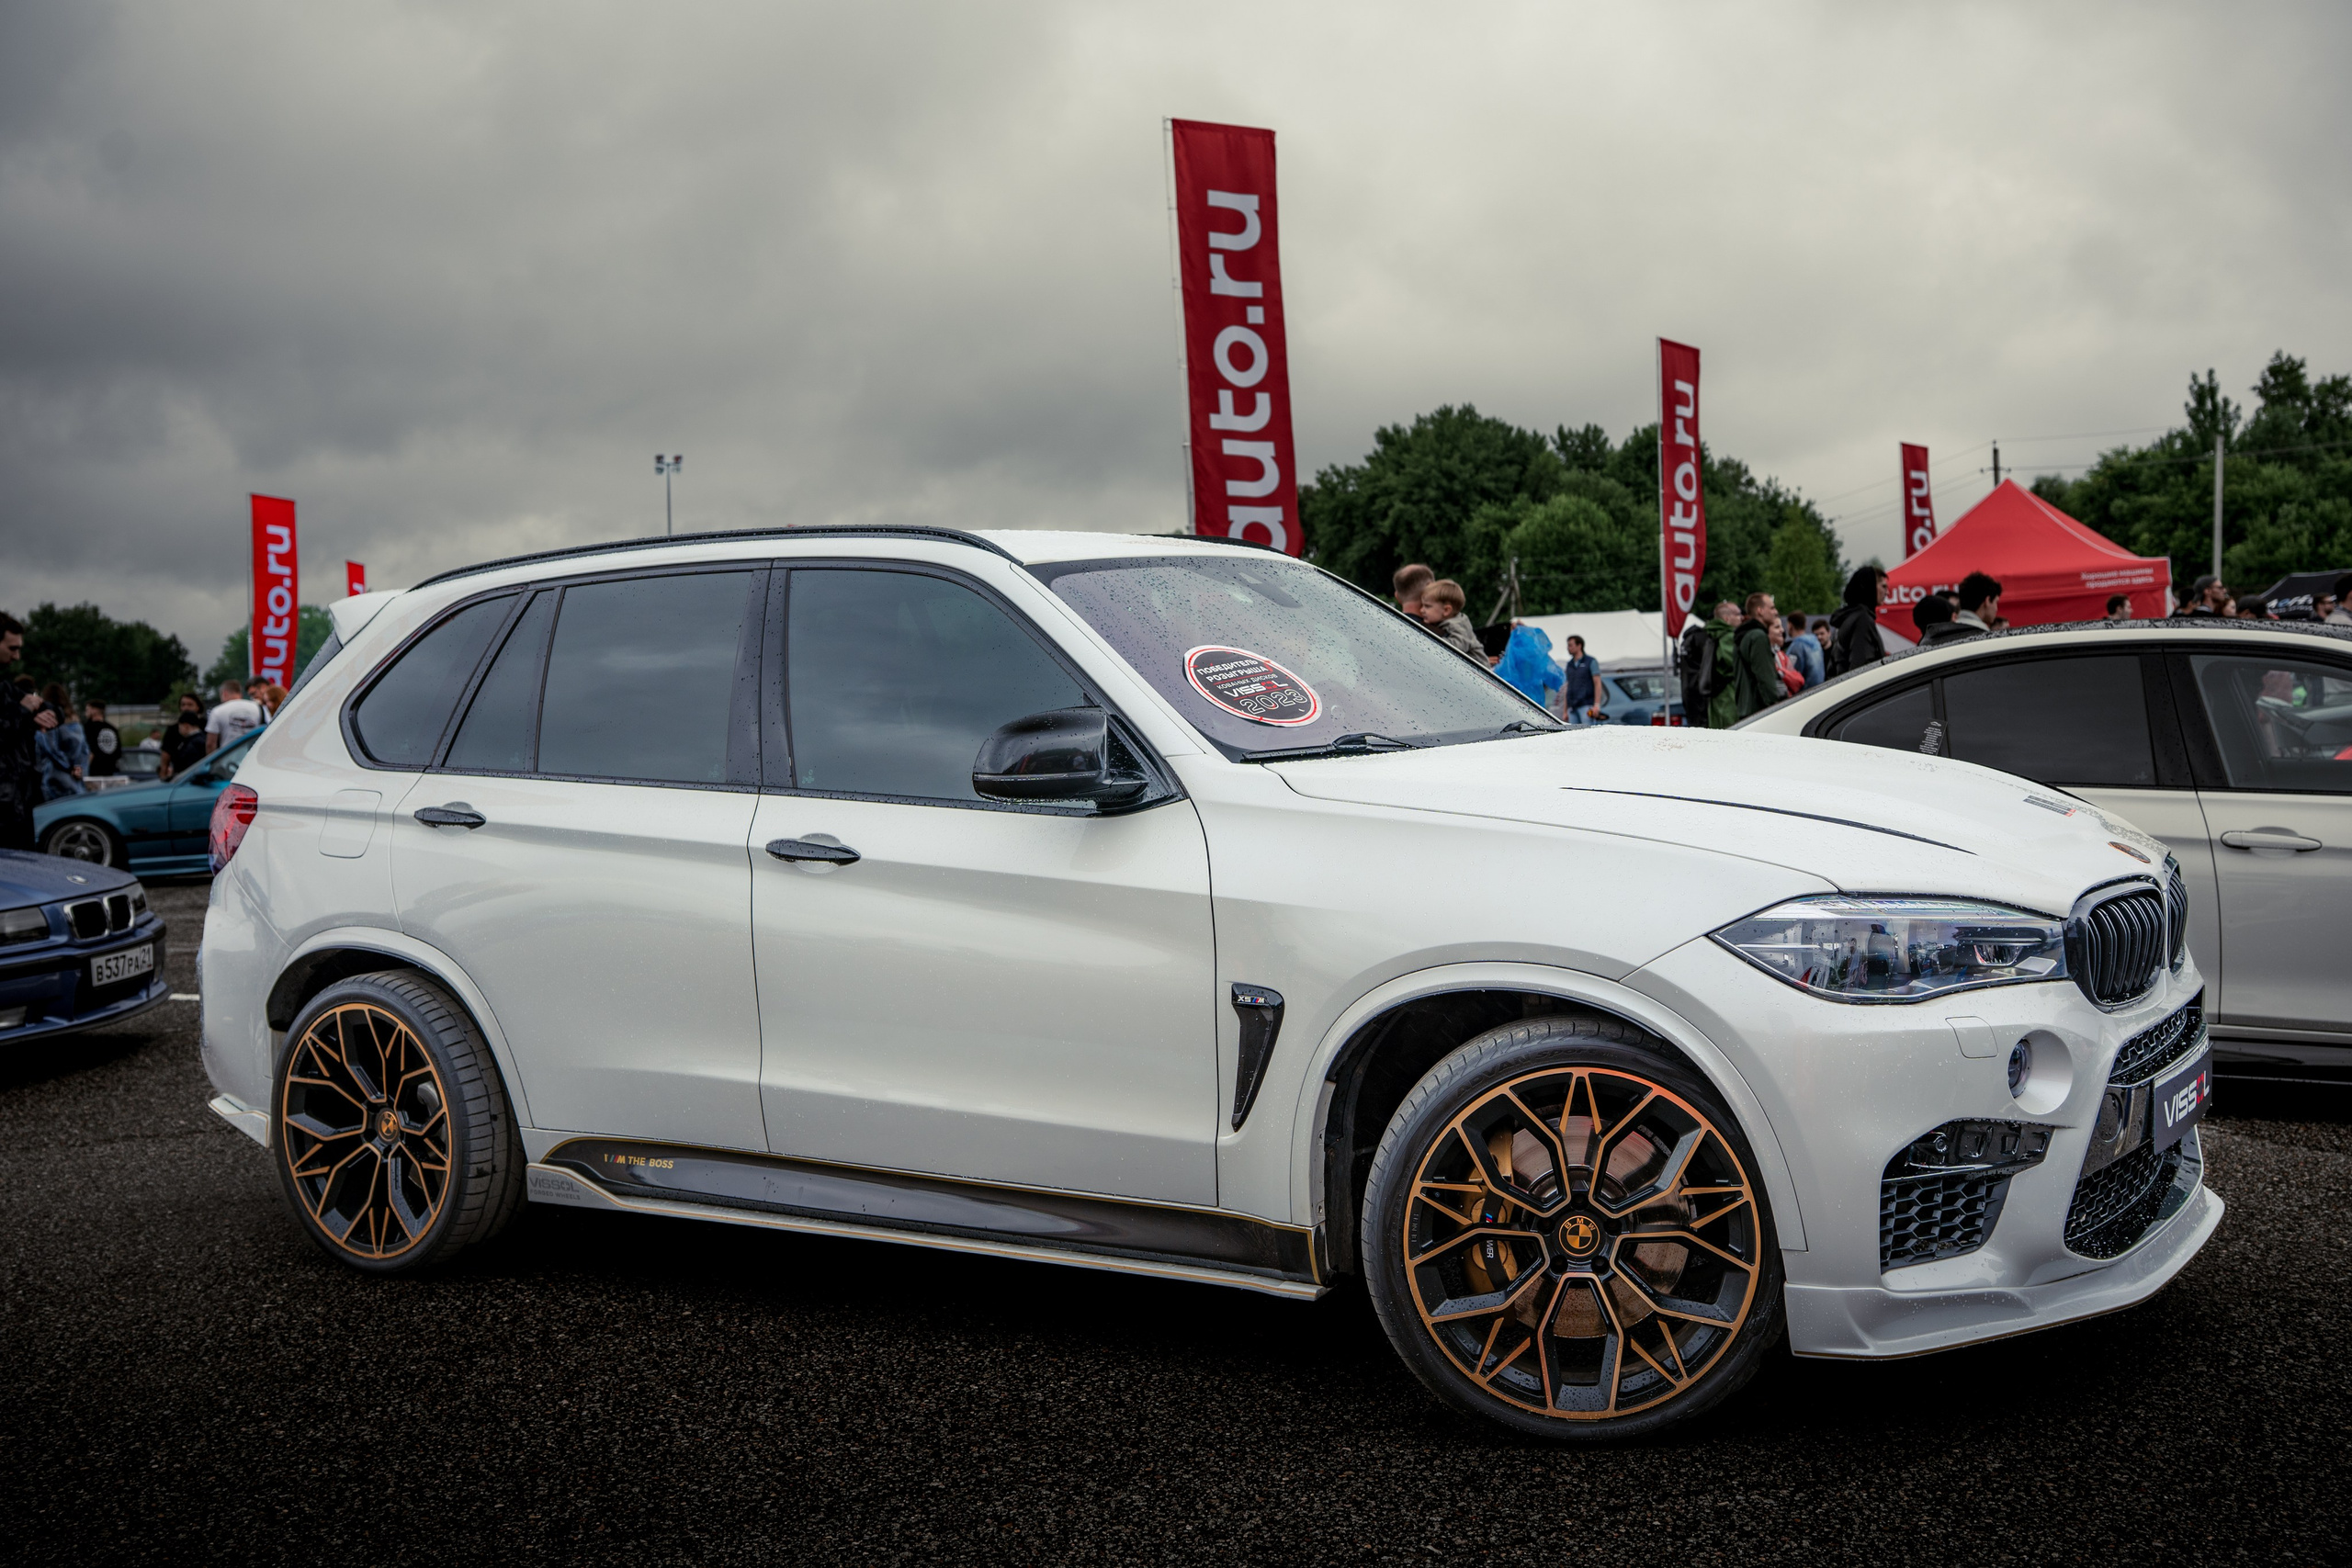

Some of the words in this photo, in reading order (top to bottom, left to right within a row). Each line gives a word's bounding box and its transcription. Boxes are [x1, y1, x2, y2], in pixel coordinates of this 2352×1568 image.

[1669, 378, 1698, 614] auto.ru
[1910, 469, 1933, 552] o.ru
[1196, 659, 1259, 675] ПОБЕДИТЕЛЬ
[1205, 665, 1269, 682] РОЗЫГРЫША
[1239, 688, 1308, 715] 2023
[2164, 1070, 2211, 1128] VISSOL
[628, 1156, 646, 1167] THE
[649, 1158, 674, 1169] BOSS
[529, 1177, 580, 1193] VISSOL
[556, 1190, 581, 1201] WHEELS
[1564, 1217, 1596, 1232] BMW
